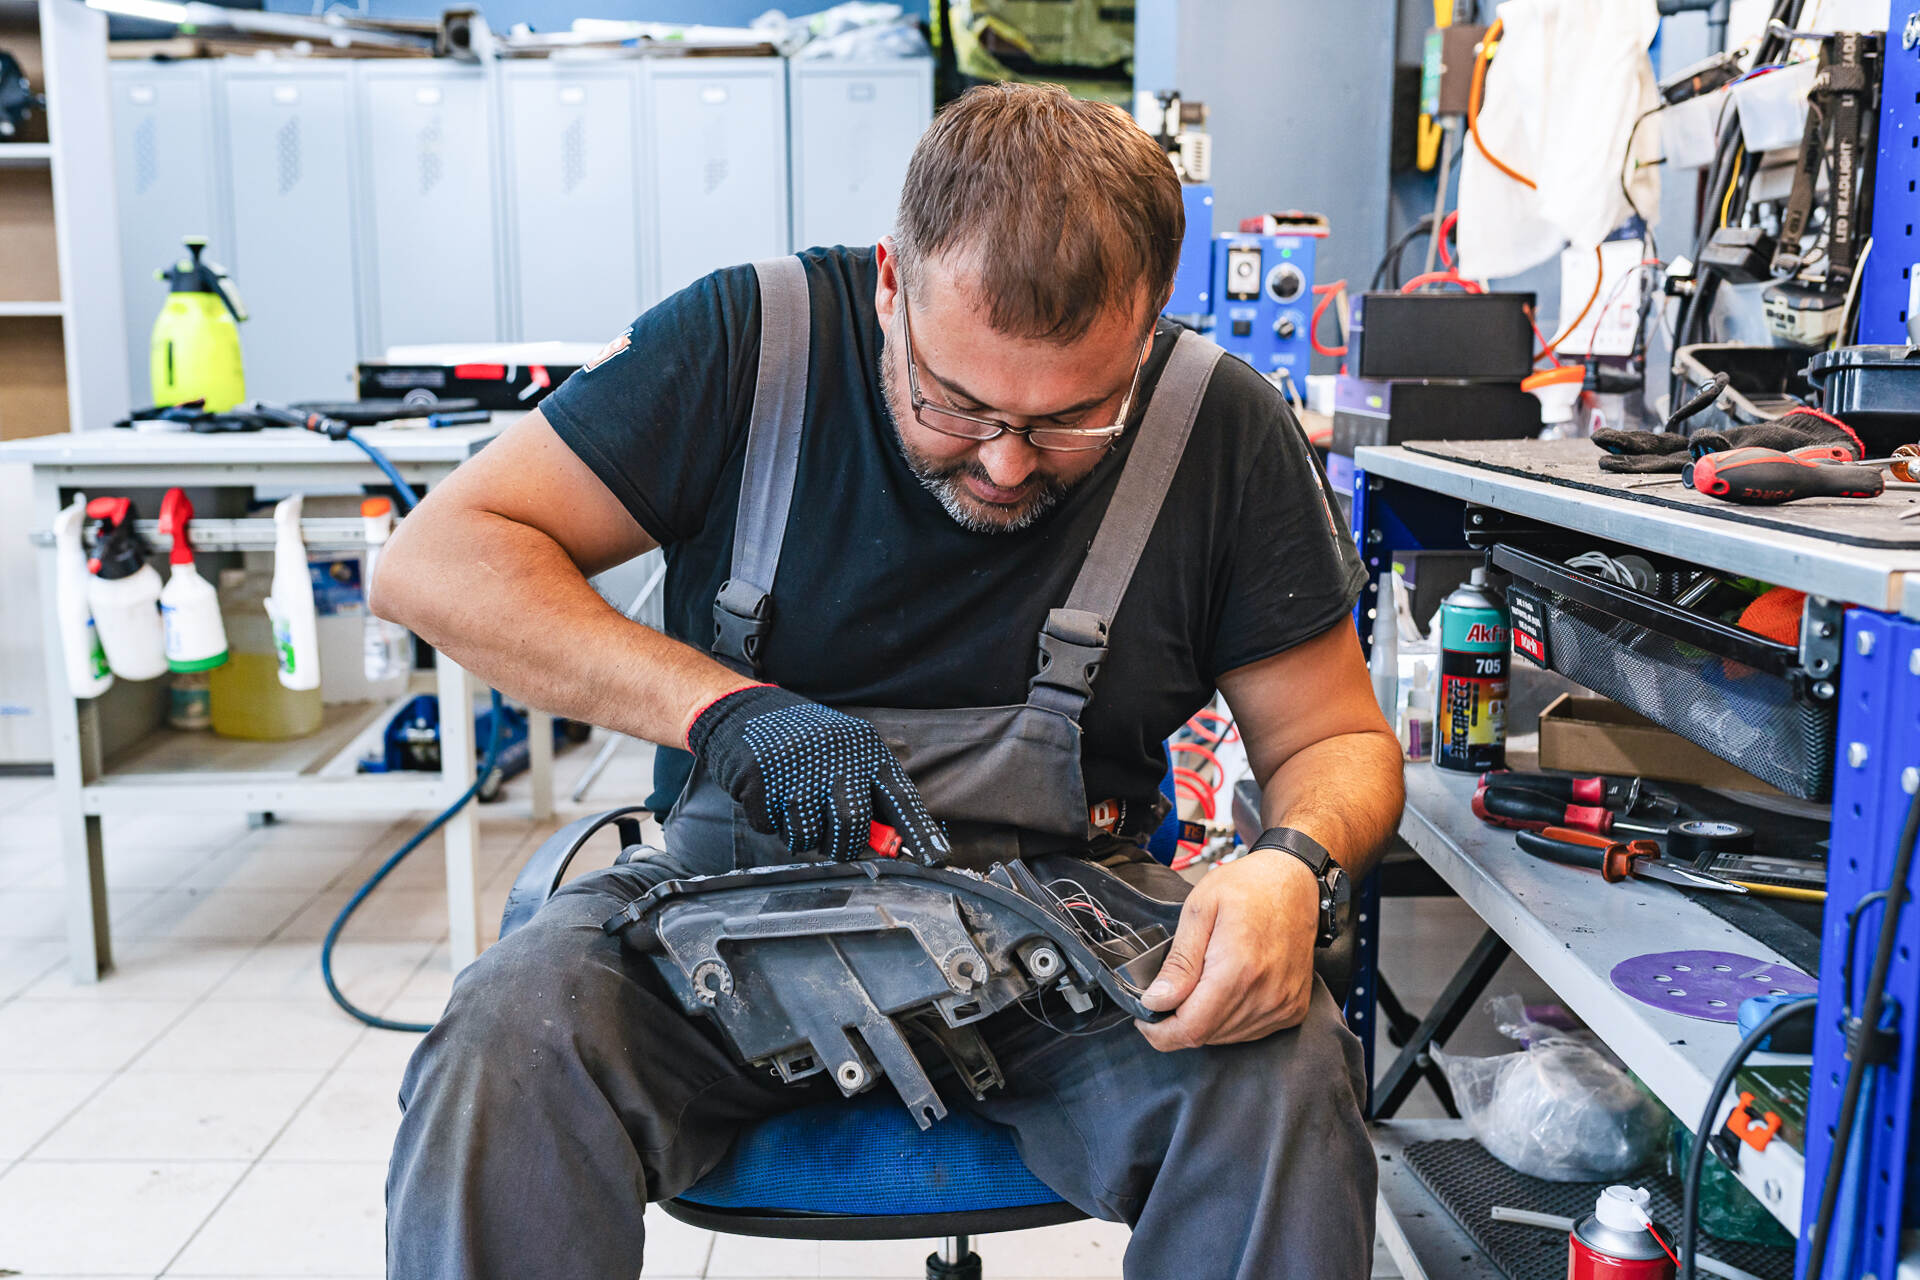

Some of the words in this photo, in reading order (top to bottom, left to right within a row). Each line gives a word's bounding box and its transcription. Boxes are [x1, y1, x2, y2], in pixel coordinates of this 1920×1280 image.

[1838, 142, 1852, 216] HEADLIGHT
[1835, 218, 1849, 243] LED
[1744, 488, 1794, 500] FORCE
[1475, 658, 1501, 674] 705
